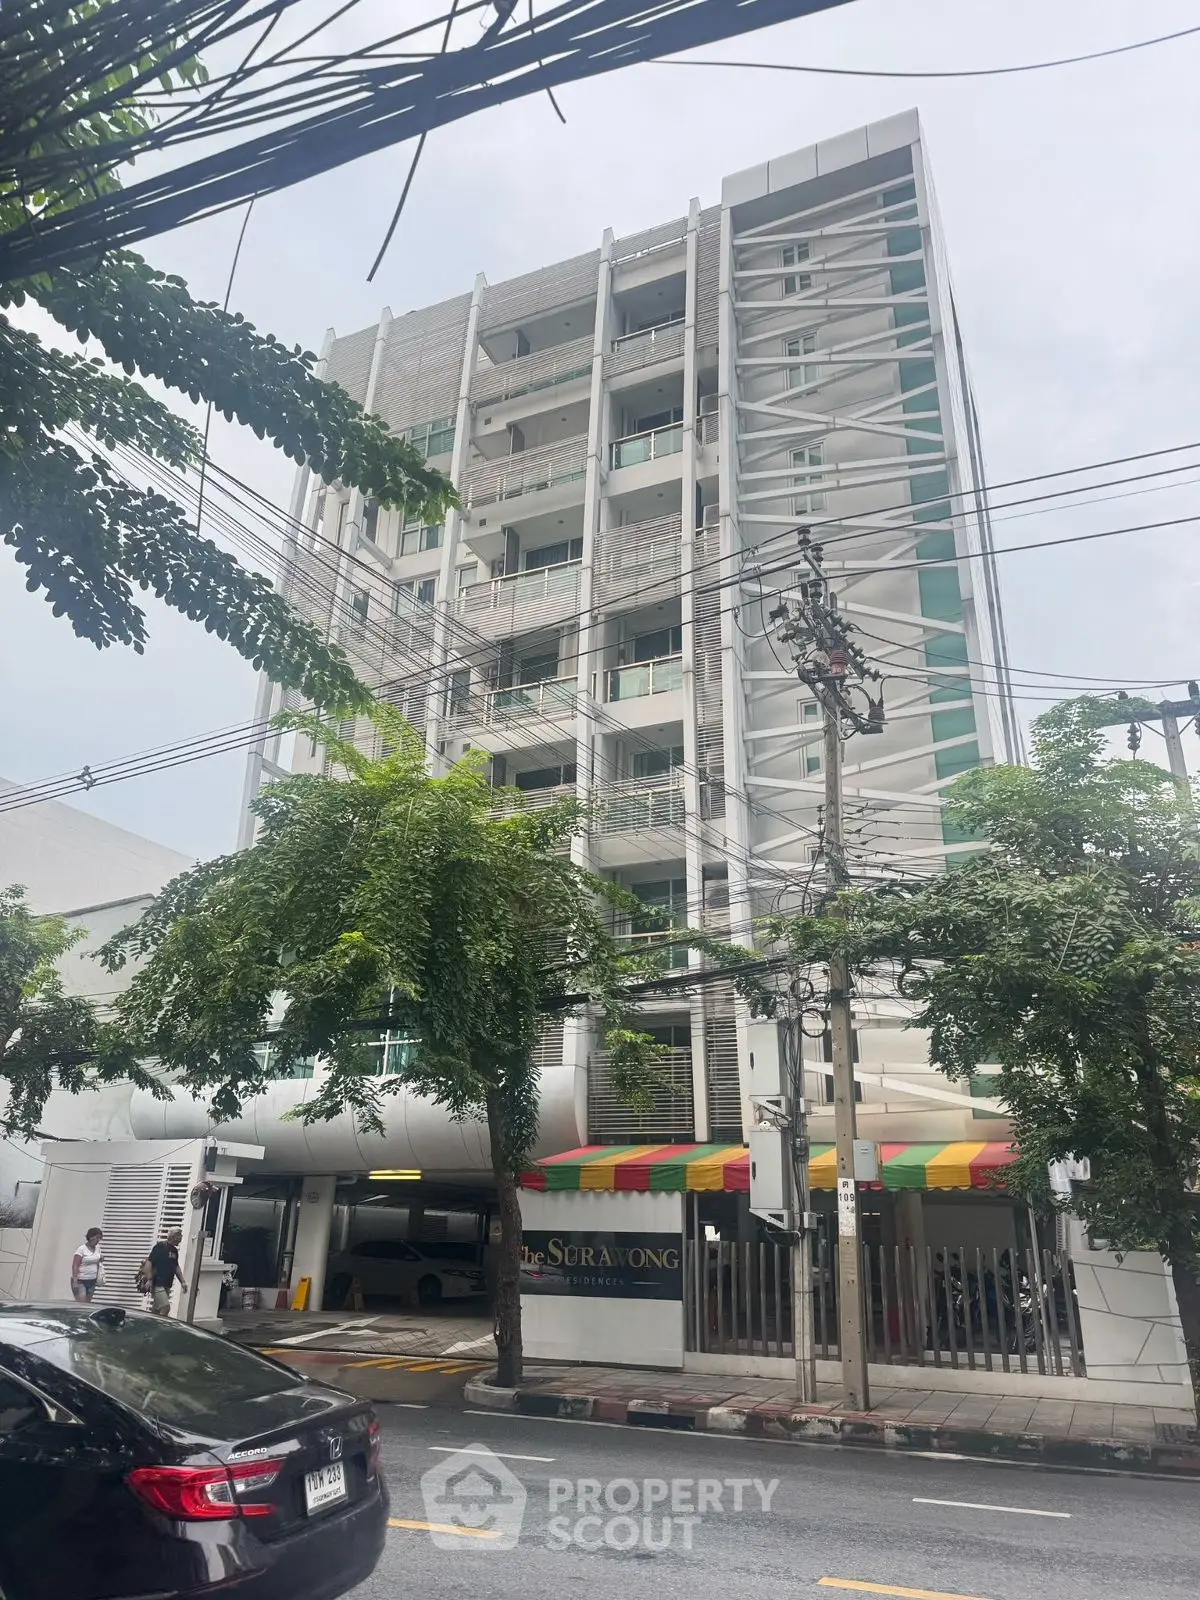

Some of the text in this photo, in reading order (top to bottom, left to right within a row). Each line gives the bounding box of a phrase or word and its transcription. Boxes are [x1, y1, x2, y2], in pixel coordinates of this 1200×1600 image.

[839, 1192, 855, 1202] 109
[520, 1245, 546, 1267] he
[227, 1447, 268, 1460] ACCORD
[327, 1464, 342, 1485] 233
